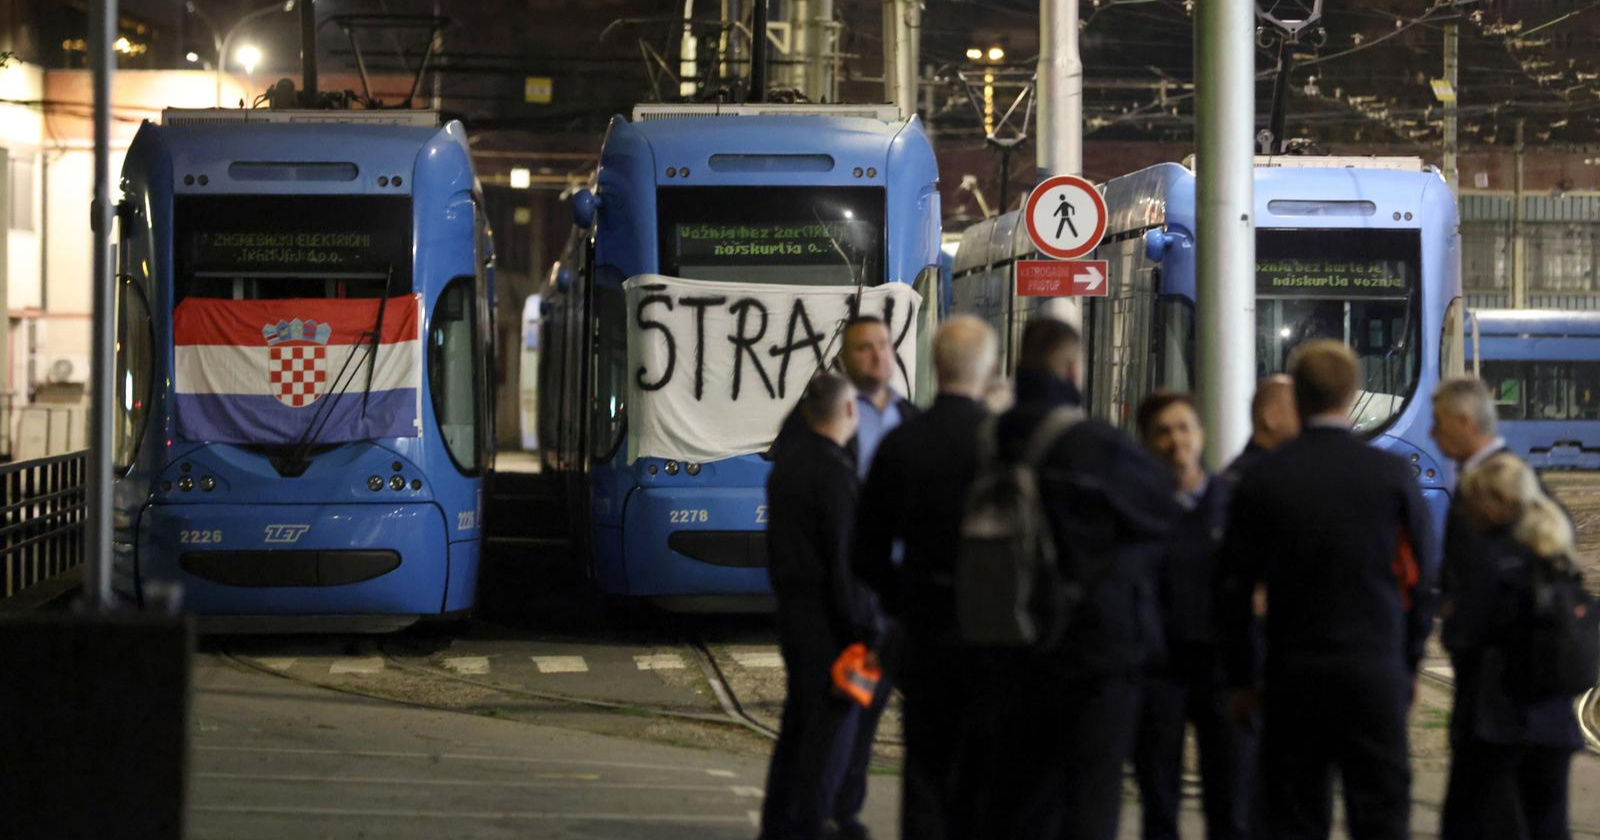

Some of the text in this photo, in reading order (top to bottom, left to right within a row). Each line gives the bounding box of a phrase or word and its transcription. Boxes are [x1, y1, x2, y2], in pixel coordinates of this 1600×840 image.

[670, 510, 709, 523] 2278
[180, 530, 222, 543] 2226
[264, 524, 310, 543] ZET
